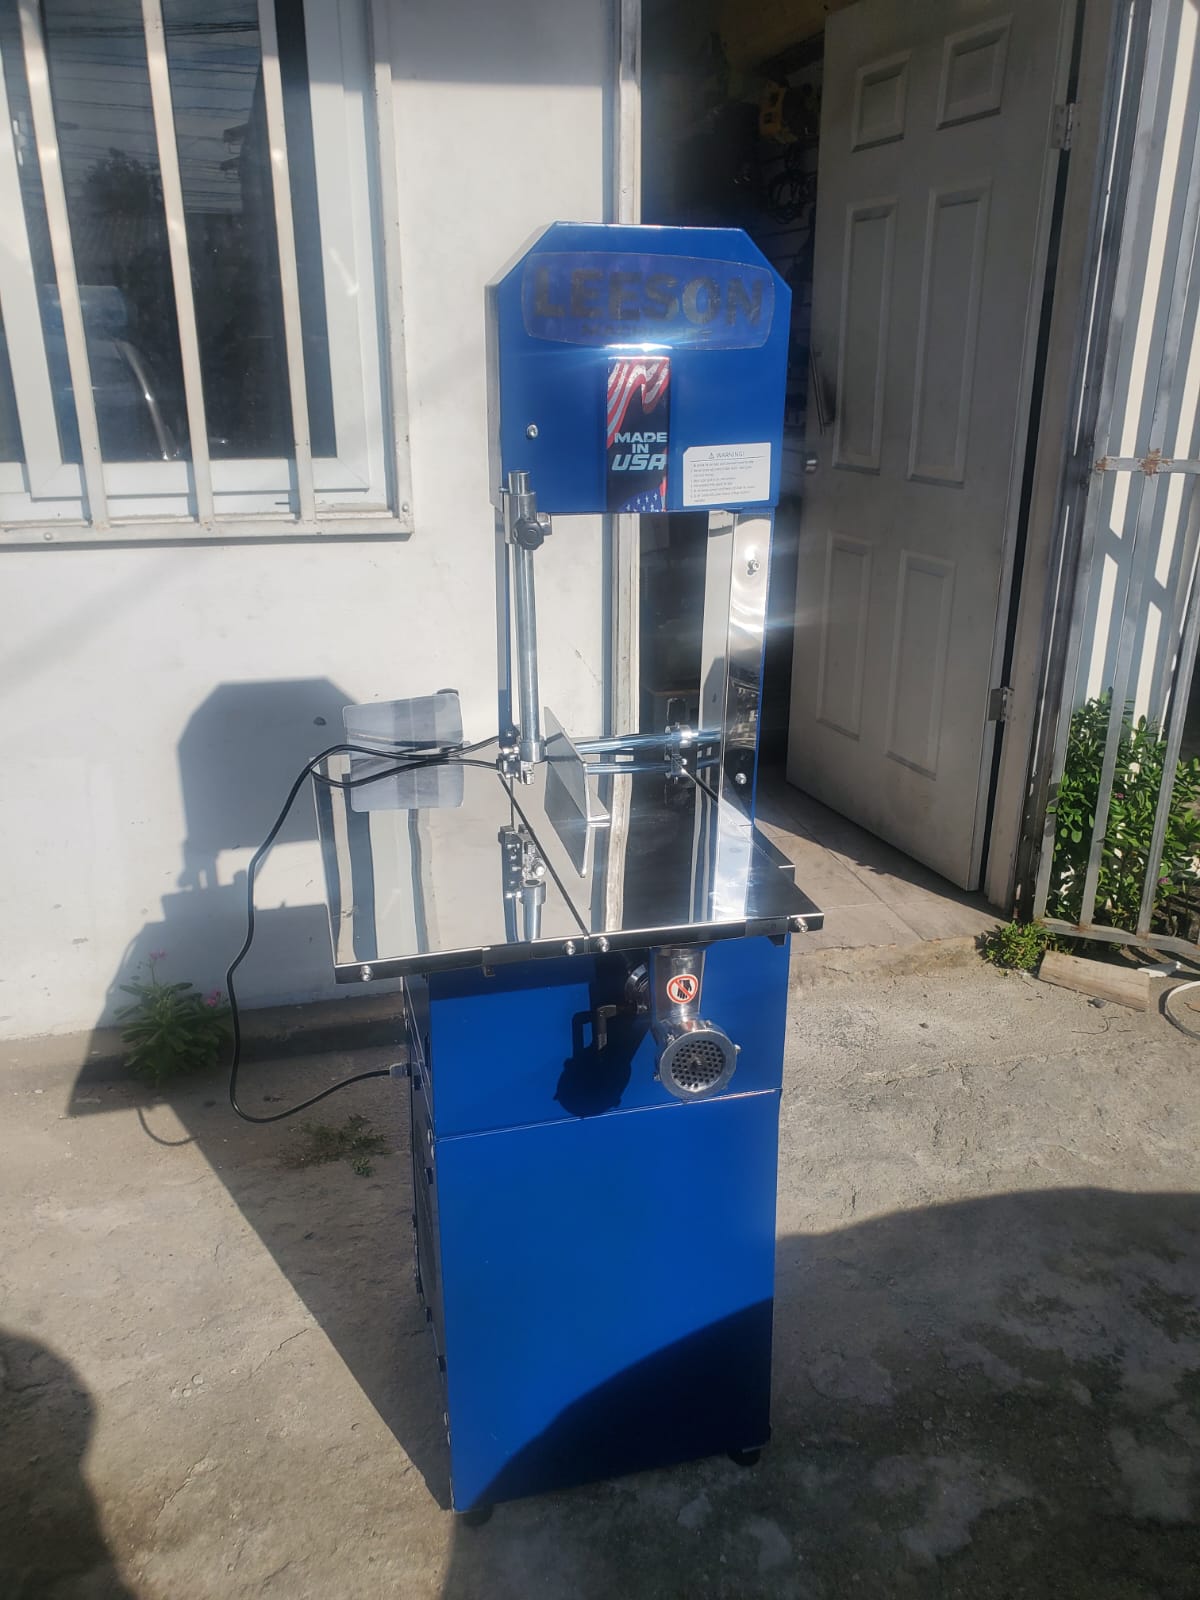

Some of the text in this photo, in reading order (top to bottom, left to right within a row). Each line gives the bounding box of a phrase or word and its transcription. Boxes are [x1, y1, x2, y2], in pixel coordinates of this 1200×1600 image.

[534, 267, 763, 326] LEESON
[614, 431, 668, 444] MADE
[631, 443, 649, 453] IN
[611, 453, 668, 471] USA
